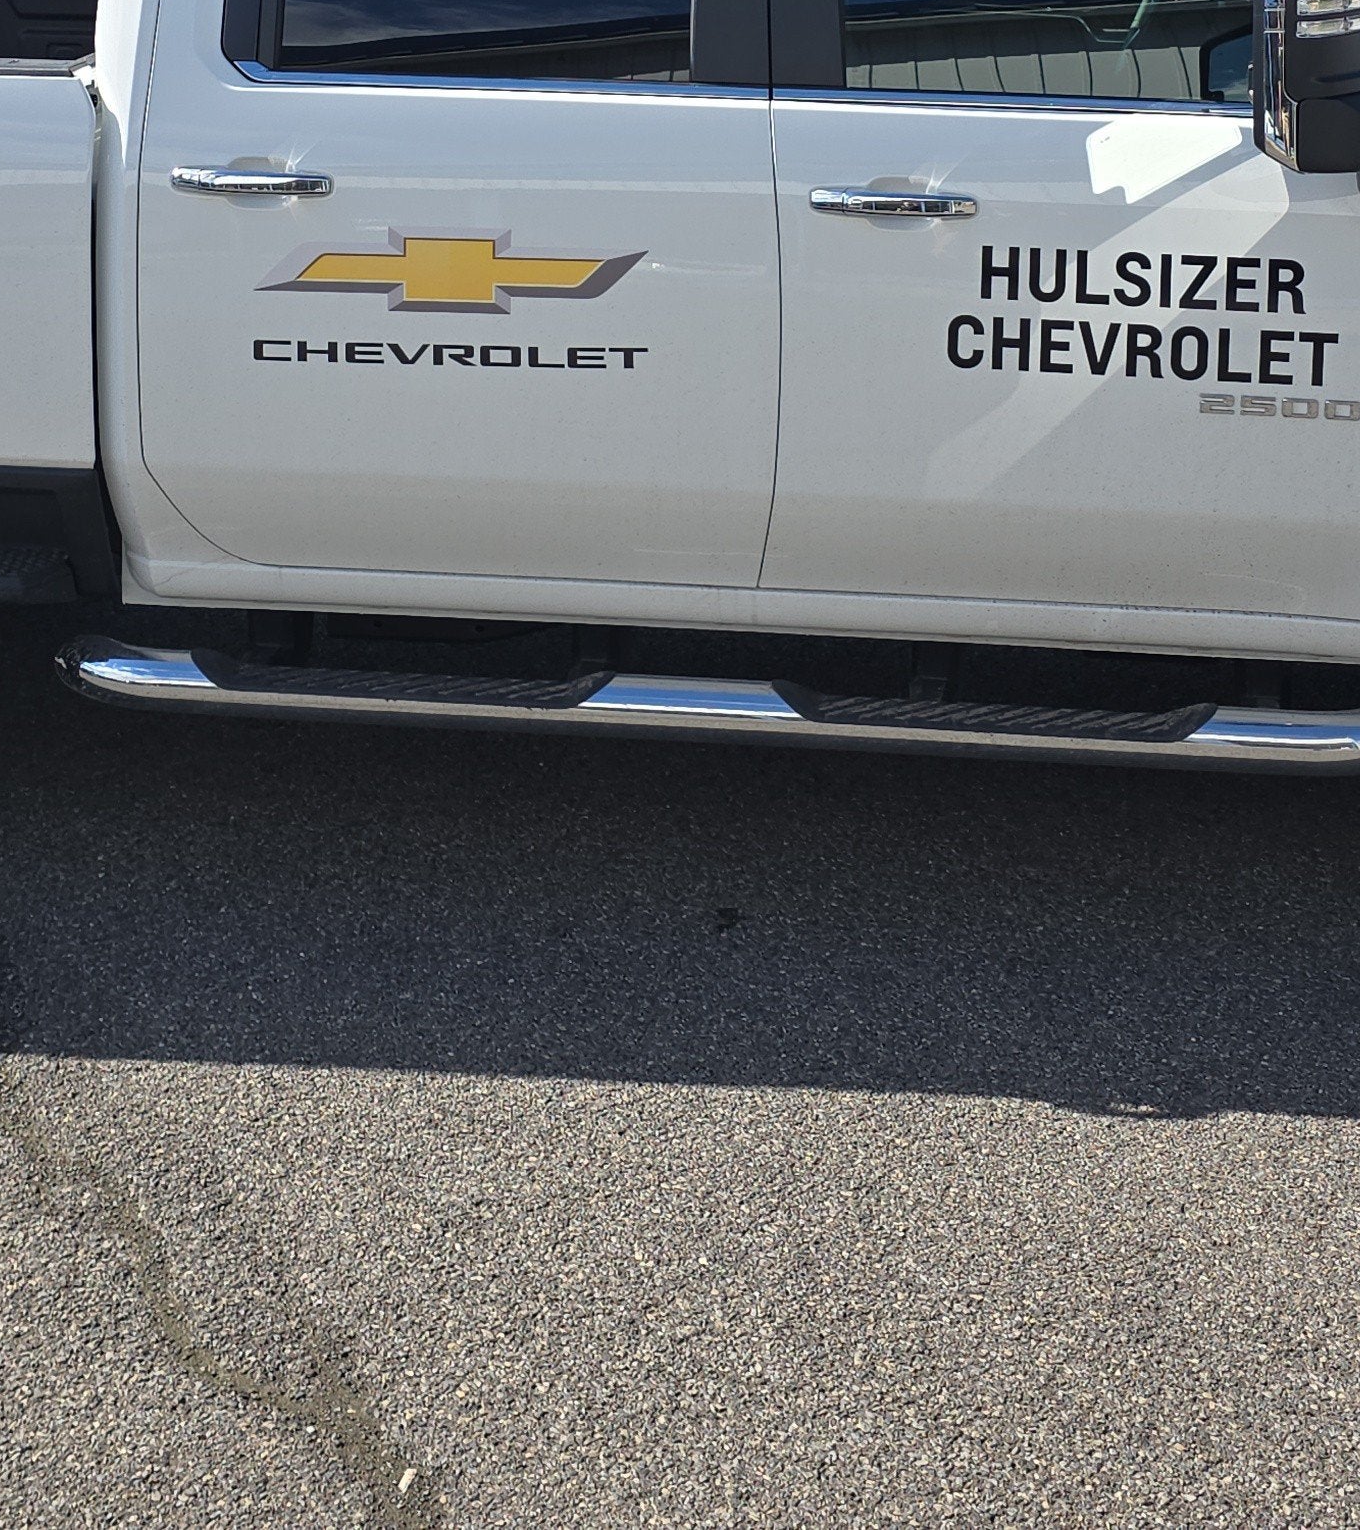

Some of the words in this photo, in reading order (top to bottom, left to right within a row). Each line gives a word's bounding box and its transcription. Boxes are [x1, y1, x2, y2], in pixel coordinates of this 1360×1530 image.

[979, 244, 1307, 315] HULSIZER
[252, 338, 650, 370] CHEVROLET
[946, 314, 1340, 387] CHEVROLET
